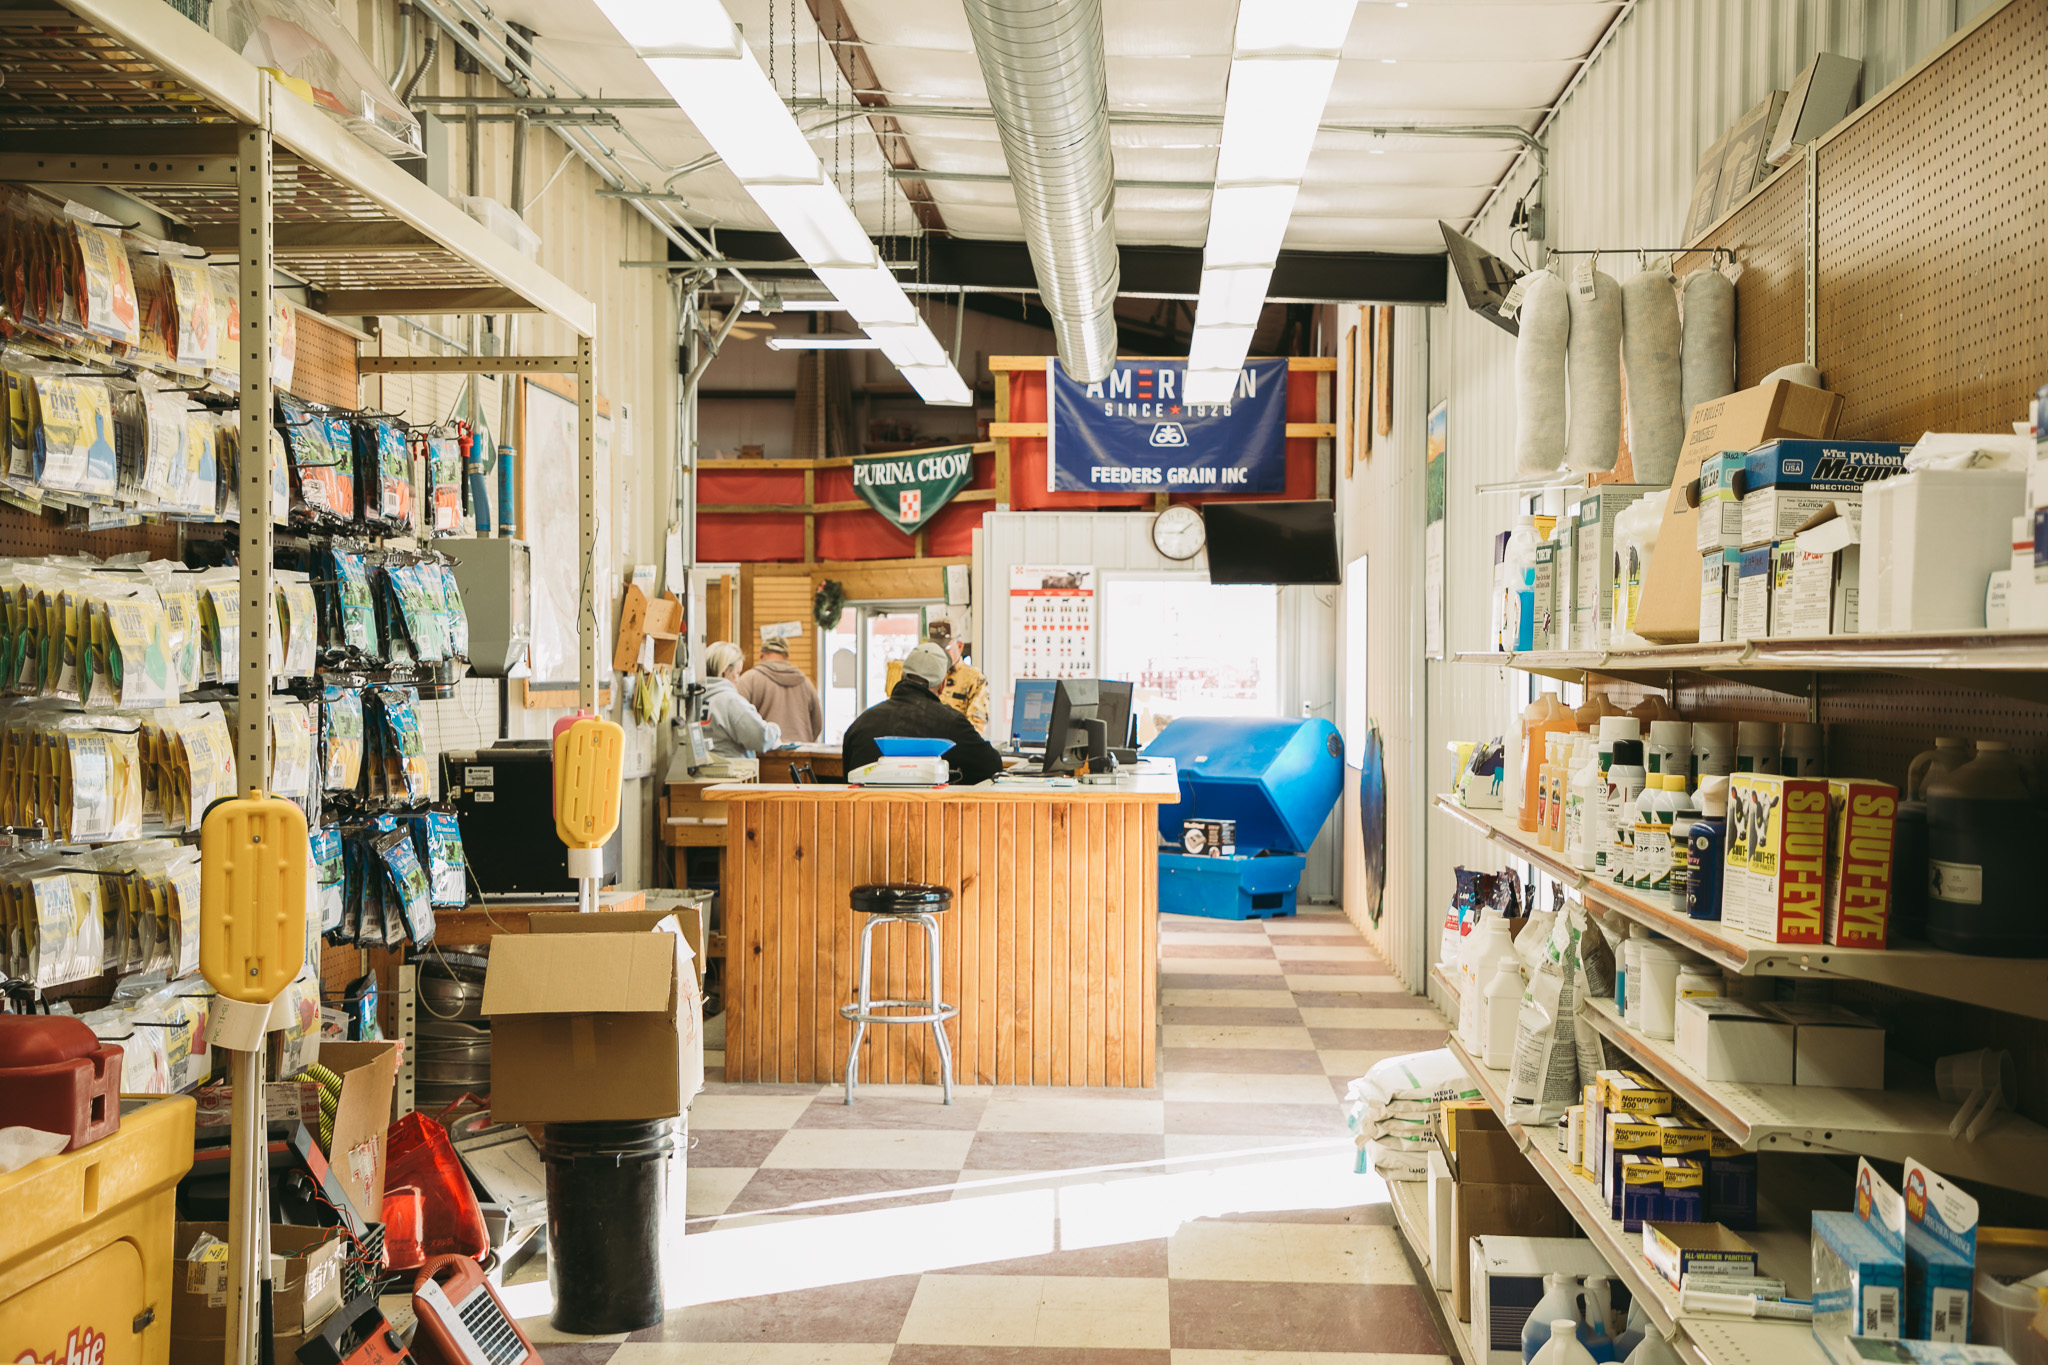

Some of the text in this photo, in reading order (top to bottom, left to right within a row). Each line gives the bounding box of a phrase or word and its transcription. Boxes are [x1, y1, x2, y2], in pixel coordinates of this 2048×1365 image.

[50, 393, 79, 413] ONE
[1104, 402, 1232, 418] SINCE 1926
[1850, 452, 1901, 466] PYthon
[853, 452, 971, 486] PURINA CHOW
[1091, 466, 1248, 484] FEEDERS GRAIN INC
[169, 605, 184, 622] ONE
[223, 598, 240, 613] ON
[191, 738, 212, 756] ONE
[1782, 790, 1826, 936] SHUT-EYE
[1842, 794, 1895, 941] SHUT-EYE
[1432, 1095, 1458, 1104] MAKER
[1621, 1101, 1650, 1110] 300 LA
[1615, 1133, 1641, 1142] 300 LA
[1908, 1187, 1923, 1219] Ultra
[1684, 1252, 1752, 1262] ALL-WEATHER PAINTSTIK
